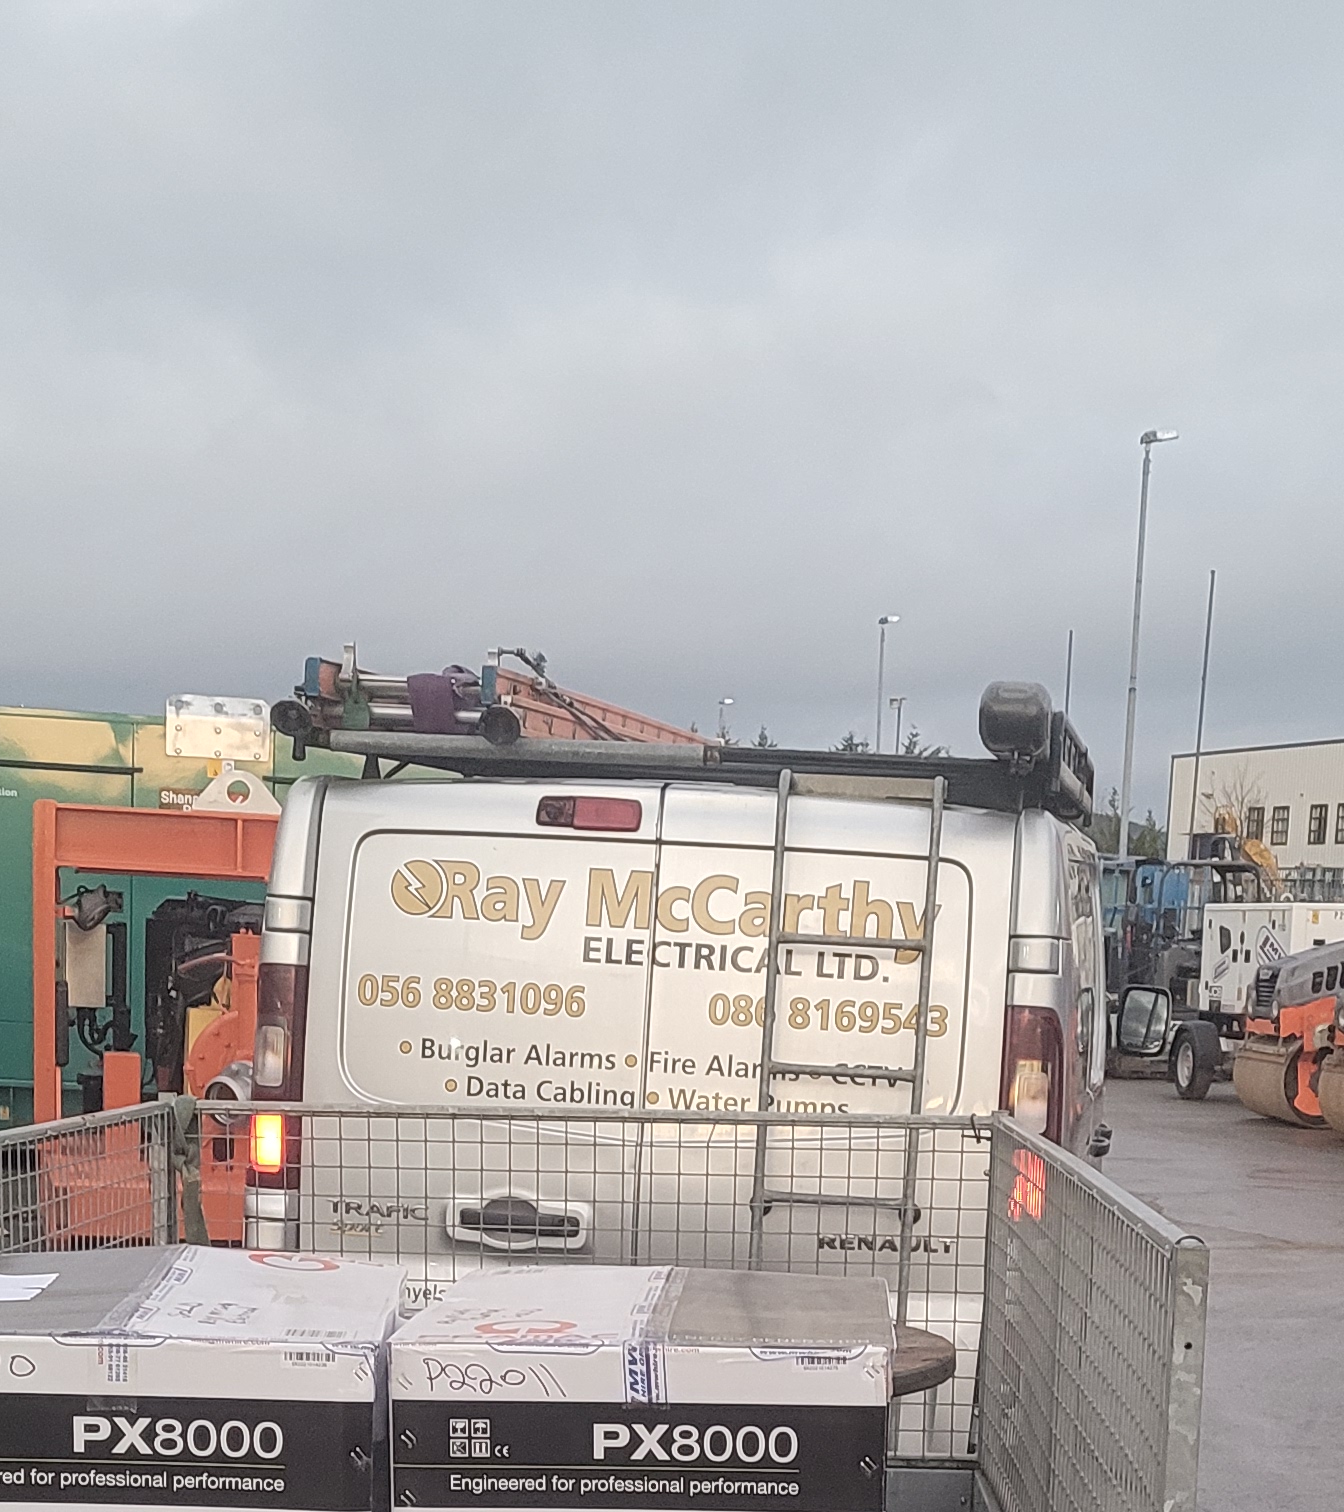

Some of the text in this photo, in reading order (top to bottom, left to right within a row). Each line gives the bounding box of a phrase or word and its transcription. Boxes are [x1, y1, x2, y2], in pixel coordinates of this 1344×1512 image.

[440, 859, 941, 965] Ray McCarthy
[582, 936, 890, 983] ELECTRICAL LTD.
[357, 974, 586, 1018] 056 8831096
[708, 993, 949, 1038] 086 8169543
[419, 1036, 516, 1070] Burglar
[522, 1043, 617, 1072] Alarms
[648, 1051, 698, 1079] Fire
[831, 1063, 904, 1088] CCTV
[466, 1076, 531, 1105] Data
[536, 1078, 636, 1109] Cabling
[667, 1086, 751, 1112] Water
[325, 1199, 429, 1221] TRAFIC
[72, 1414, 284, 1459] PX8000
[593, 1423, 799, 1464] PX8000
[29, 1468, 55, 1486] for
[60, 1469, 168, 1493] professional
[172, 1472, 285, 1493] performance
[449, 1474, 800, 1498] Engineered for professional performance
